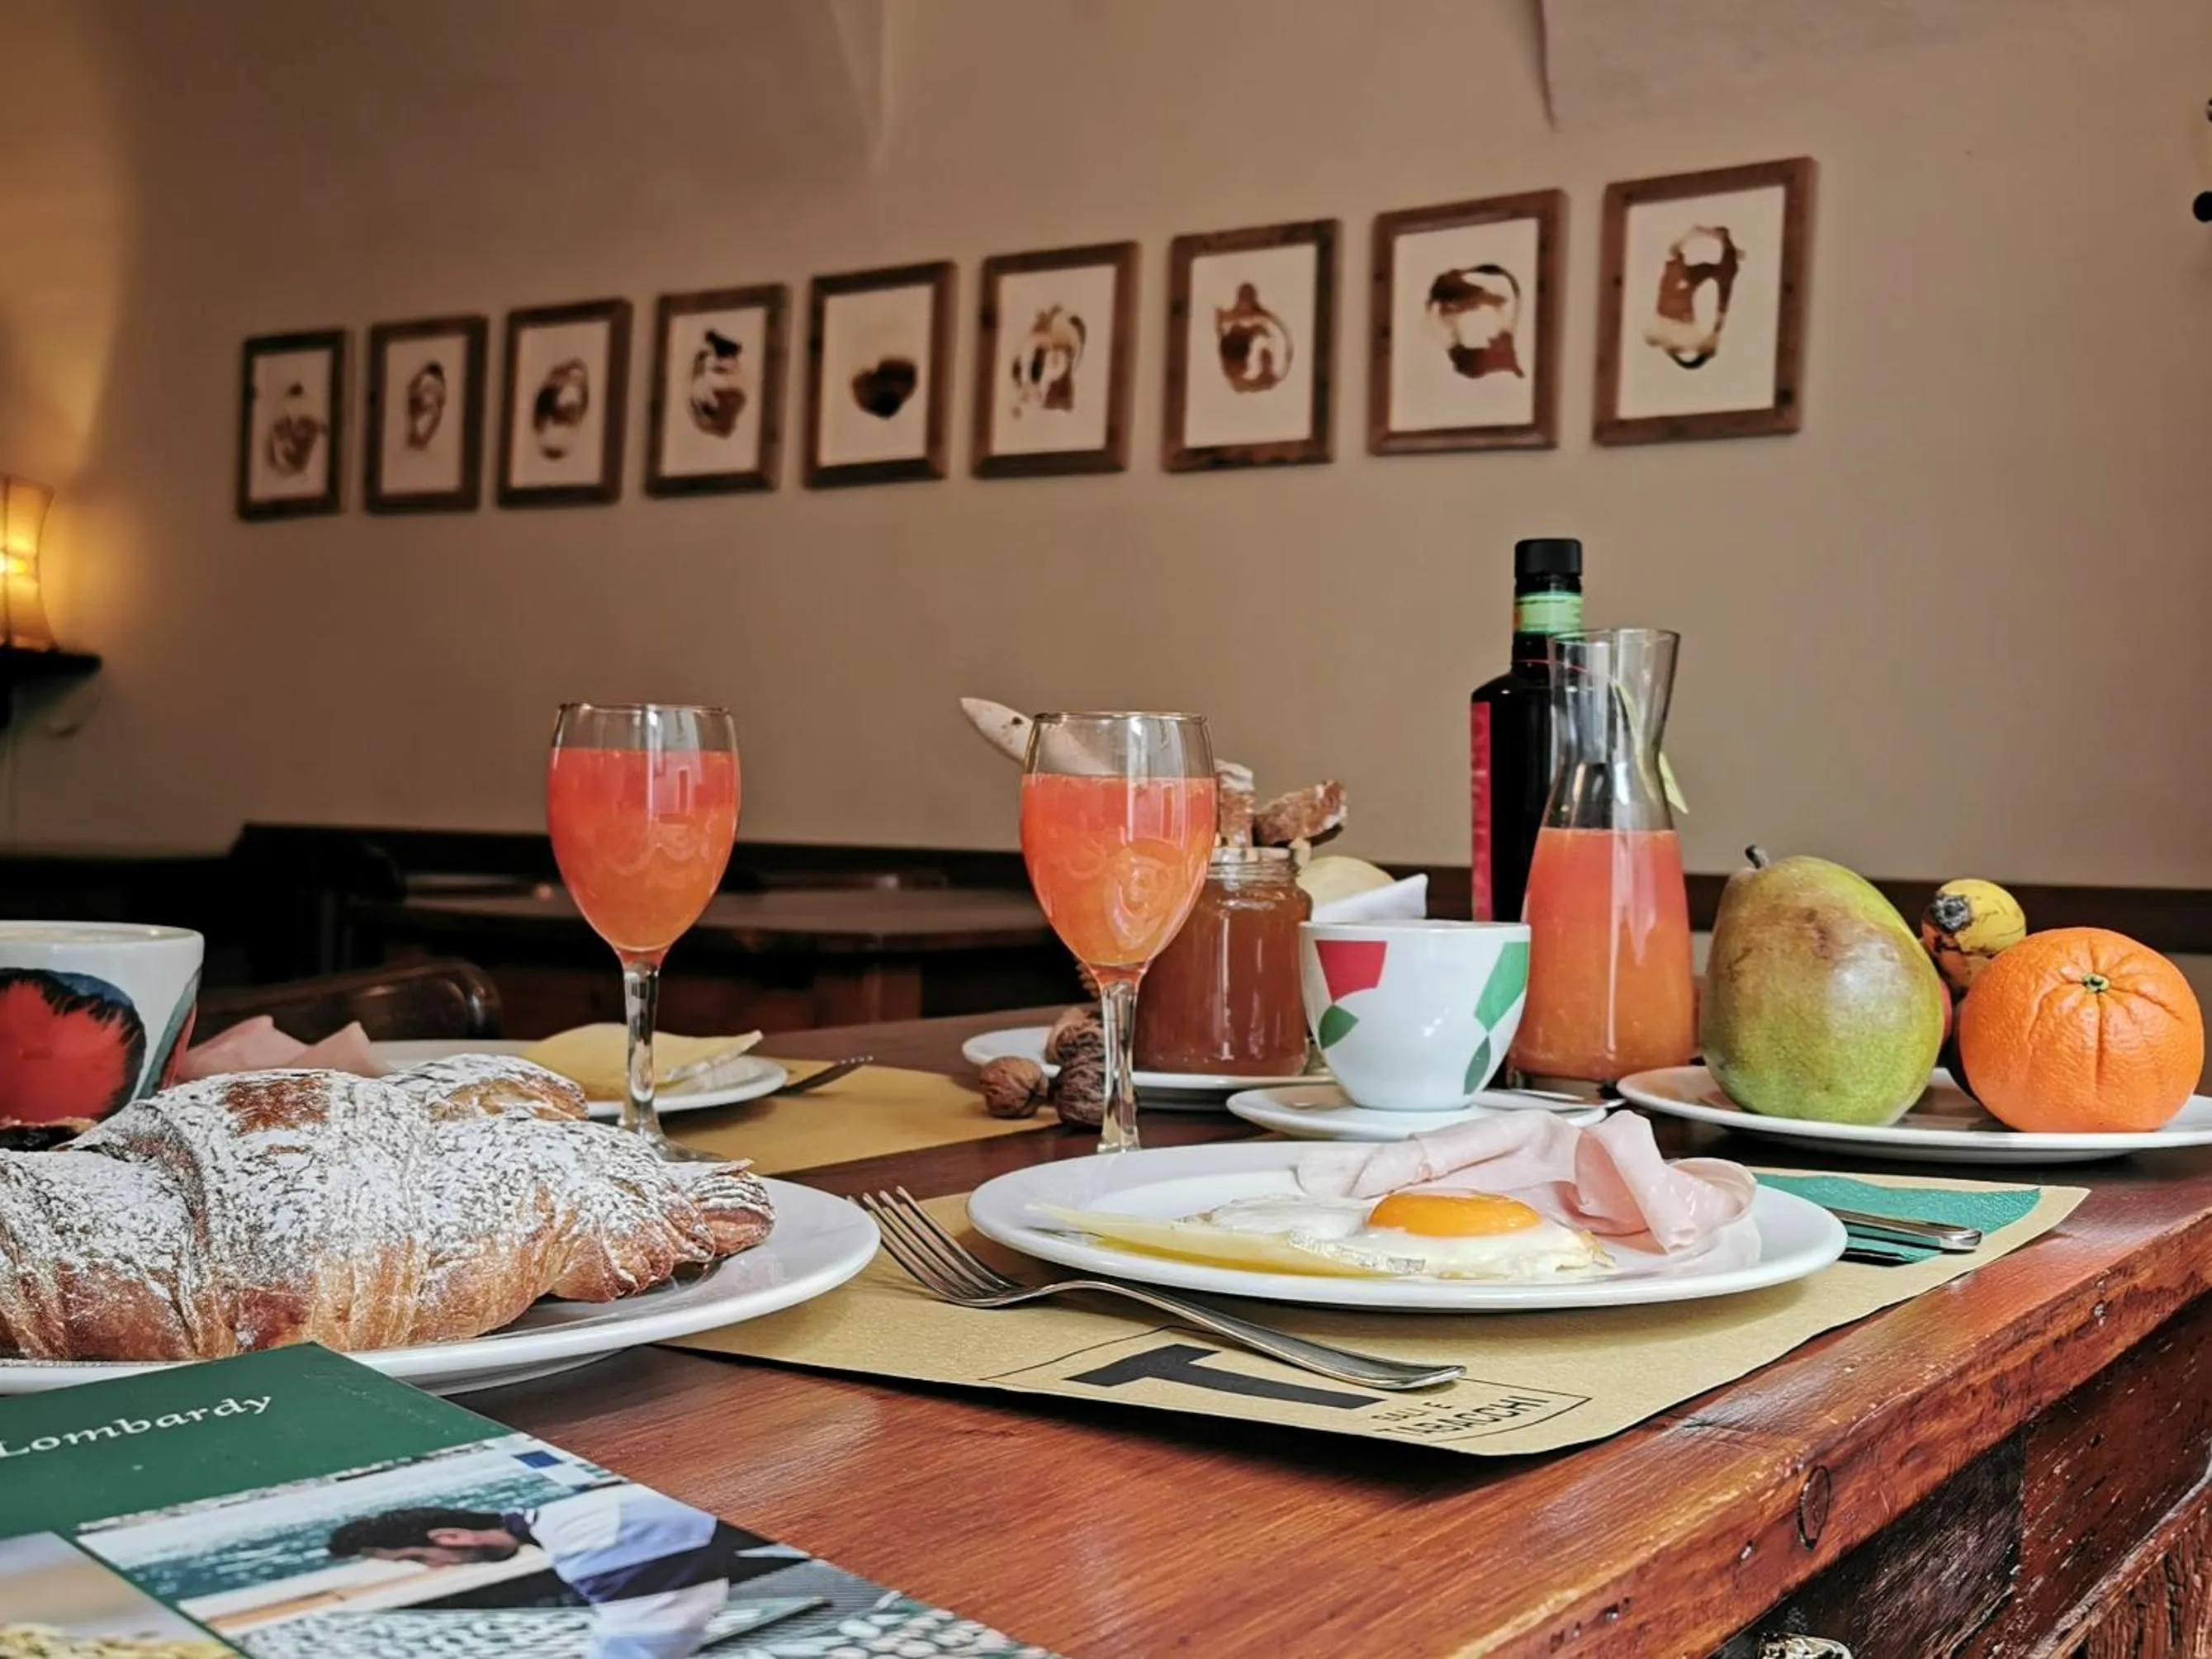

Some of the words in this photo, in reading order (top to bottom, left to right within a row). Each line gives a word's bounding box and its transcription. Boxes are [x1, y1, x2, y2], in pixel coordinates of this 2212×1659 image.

[1372, 1395, 1551, 1437] TABACCHI
[1423, 1401, 1452, 1410] E
[0, 1396, 272, 1458] Lombardy
